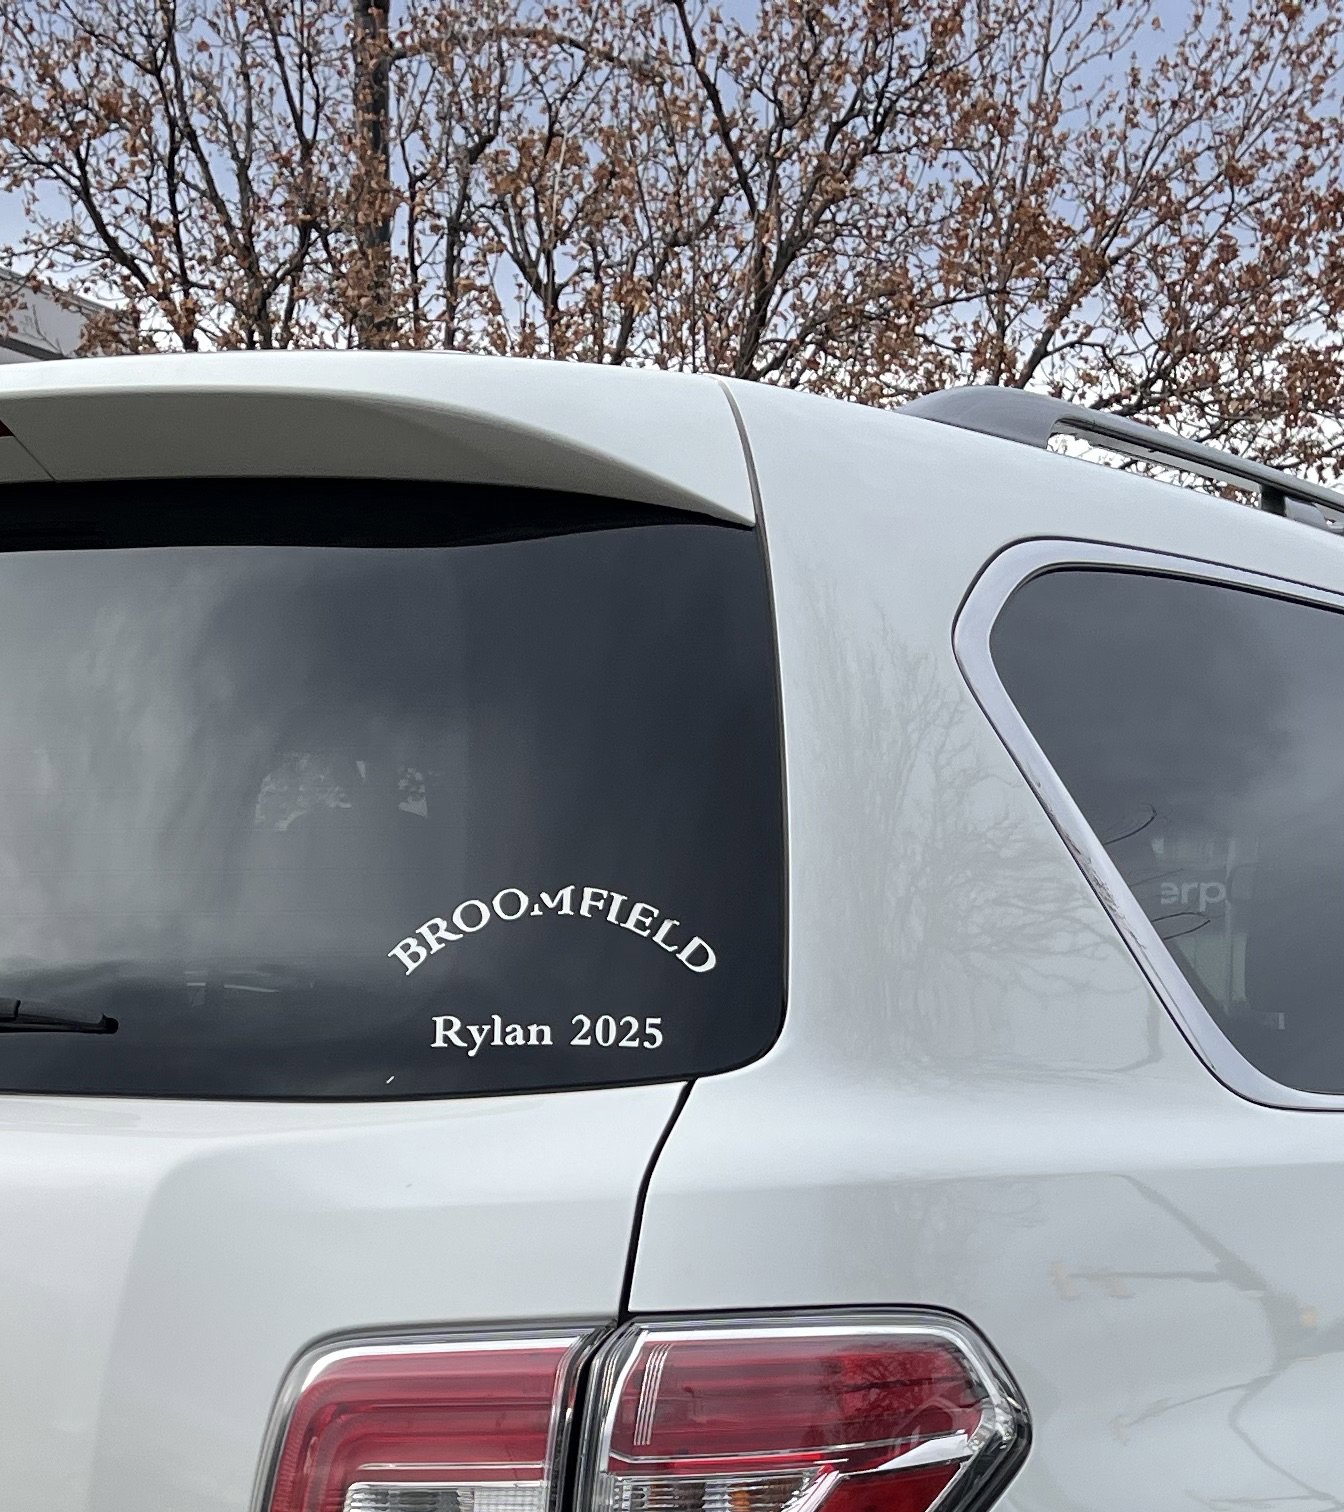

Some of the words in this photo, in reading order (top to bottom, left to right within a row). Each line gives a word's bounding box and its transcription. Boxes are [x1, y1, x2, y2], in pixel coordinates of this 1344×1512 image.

[388, 885, 717, 976] BROOMFIELD
[430, 1014, 554, 1057] Rylan
[570, 1014, 664, 1049] 2025
